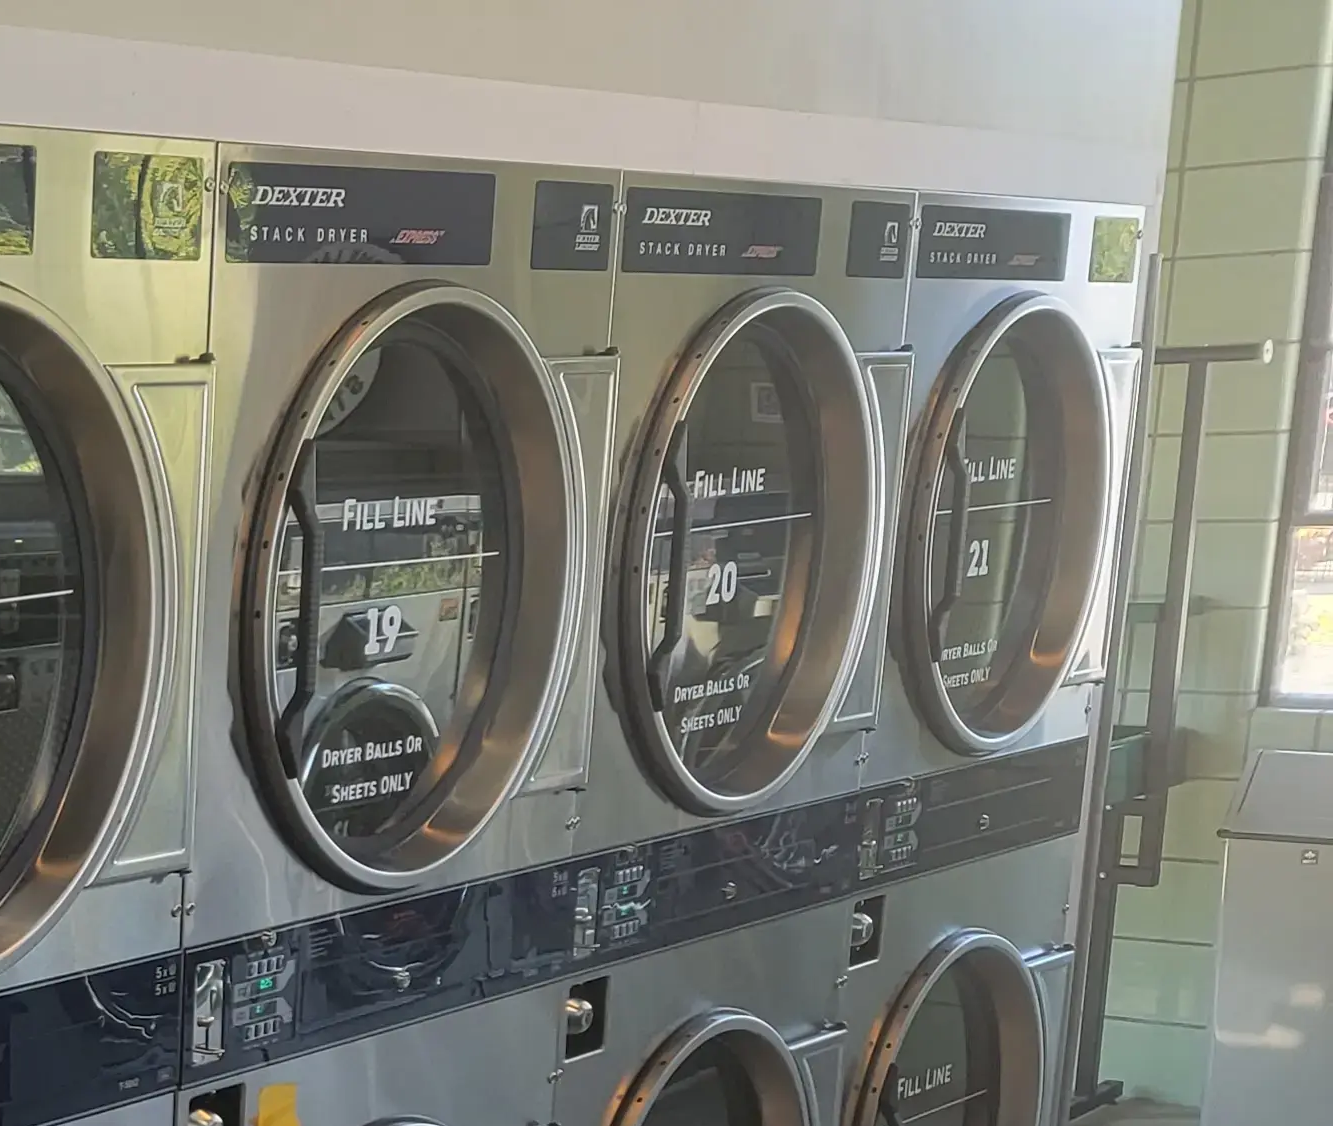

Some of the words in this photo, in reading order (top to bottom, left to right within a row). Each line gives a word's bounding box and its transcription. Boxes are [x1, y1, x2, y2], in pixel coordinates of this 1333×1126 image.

[251, 185, 346, 209] DEXTER
[641, 207, 711, 227] DEXTER
[933, 222, 987, 239] DEXTER
[249, 225, 307, 242] STACK
[316, 227, 369, 244] DRYER
[639, 241, 681, 256] STACK
[688, 243, 727, 257] DRYER
[693, 469, 727, 499] FILL
[731, 466, 766, 495] LINE
[964, 457, 985, 483] ILL
[989, 456, 1016, 481] LINE
[342, 497, 386, 532] FILL
[392, 495, 438, 528] LINE
[966, 539, 989, 578] 21
[705, 560, 738, 606] 20
[364, 604, 402, 656] 19
[940, 645, 962, 661] RYER
[963, 642, 985, 658] BALLS
[674, 684, 704, 704] DRYER
[706, 678, 735, 698] BALLS
[737, 672, 750, 690] OR
[943, 672, 969, 688] SHEETS
[970, 666, 991, 684] ONLY
[680, 712, 715, 734] SHEETS
[717, 704, 743, 726] ONLY
[322, 746, 362, 770] DRYER
[364, 738, 403, 761] BALLS
[406, 734, 423, 753] OR
[331, 779, 378, 805] SHEETS
[380, 771, 414, 794] ONLY
[897, 1076, 922, 1100] FILL
[925, 1063, 953, 1091] LINE
